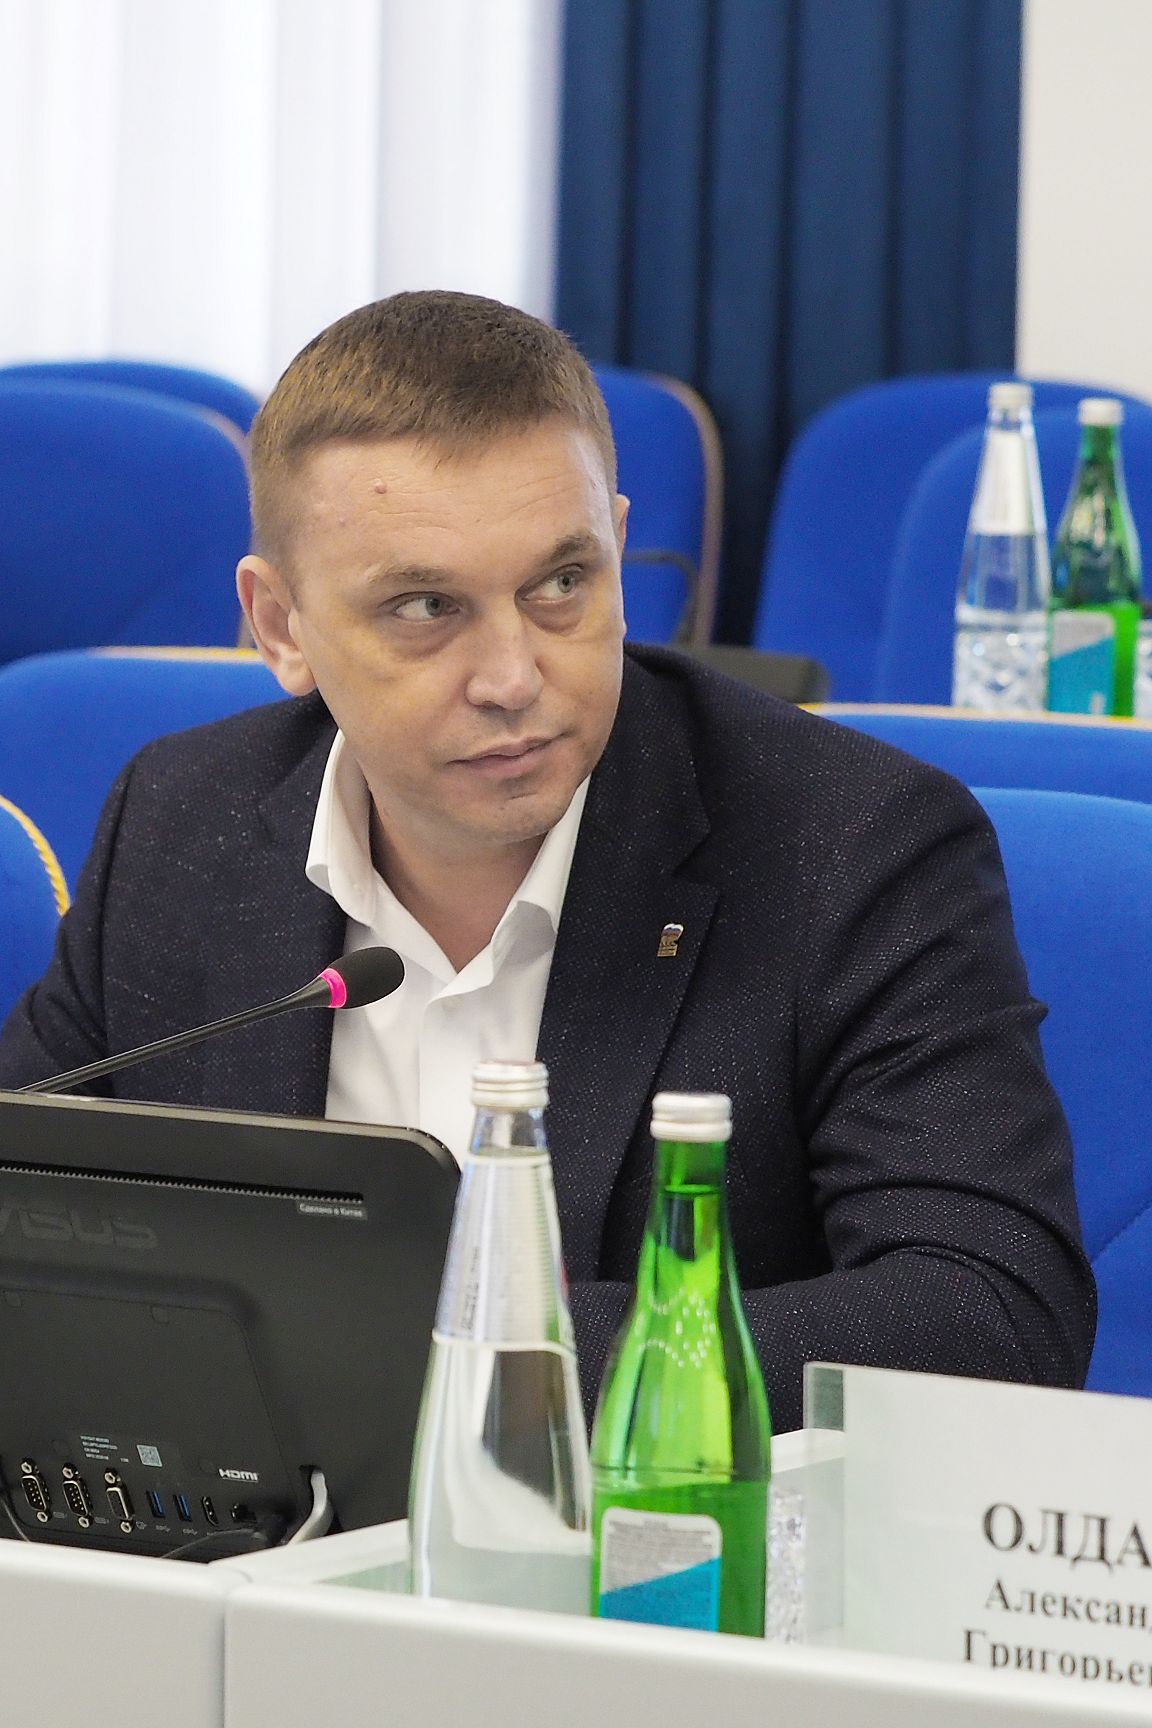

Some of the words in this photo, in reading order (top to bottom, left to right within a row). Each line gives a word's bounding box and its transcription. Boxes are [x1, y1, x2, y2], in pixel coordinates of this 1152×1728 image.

[218, 1467, 259, 1482] HDMI
[982, 1502, 1152, 1576] ОЛДА
[985, 1576, 1152, 1634] Алексан
[962, 1627, 1152, 1688] Григорье
